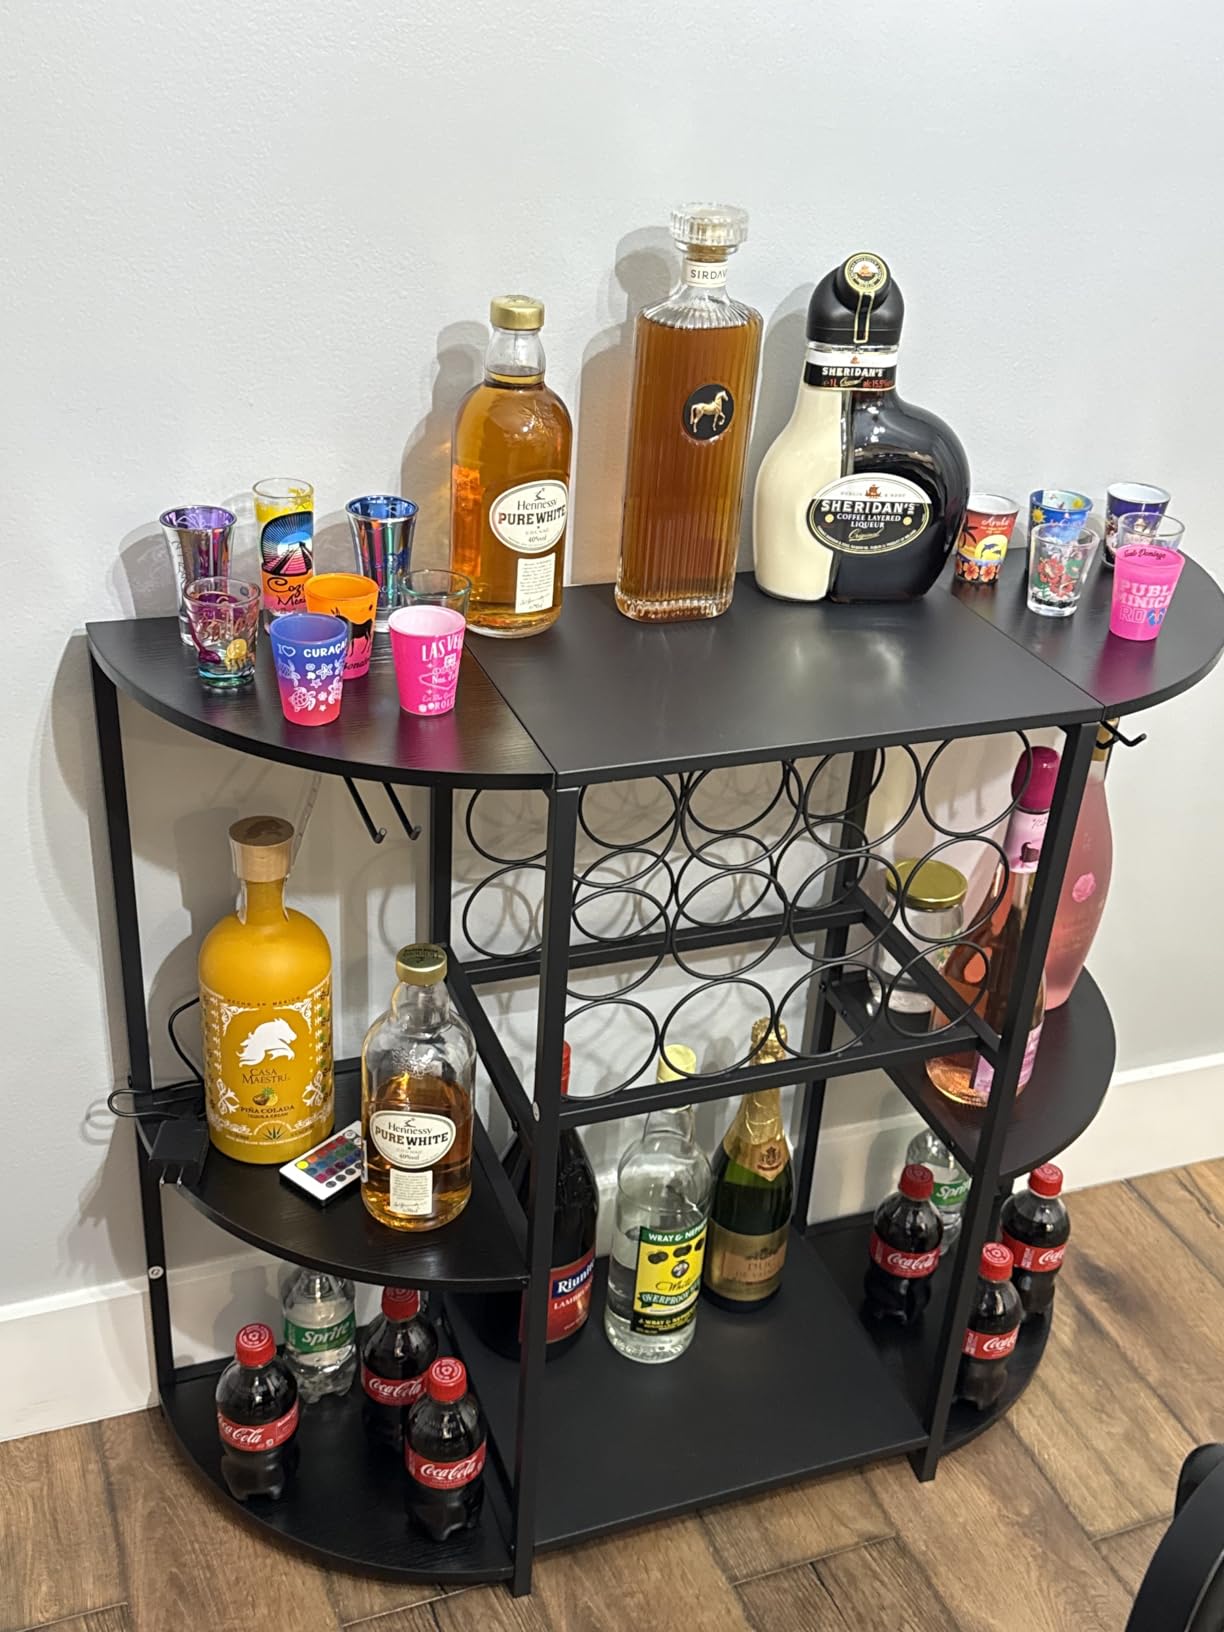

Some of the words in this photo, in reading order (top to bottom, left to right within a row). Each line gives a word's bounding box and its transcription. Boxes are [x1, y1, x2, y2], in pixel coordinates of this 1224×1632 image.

[822, 367, 884, 377] SHERIDAN'S
[517, 497, 558, 511] Hennessy
[821, 500, 915, 515] SHERIDAN'S
[498, 512, 535, 525] PURE
[536, 504, 566, 524] WHITE
[837, 513, 866, 521] COFFEE
[867, 514, 901, 522] LAYERED
[850, 521, 885, 529] LIQUEUR
[421, 639, 446, 662] LAS
[249, 1068, 278, 1078] CASA
[240, 1105, 258, 1114] PIÑA
[260, 1105, 295, 1115] COLADA
[388, 1121, 432, 1136] Hennessy
[375, 1126, 405, 1146] PURE
[405, 1131, 449, 1147] WHITE
[648, 1232, 674, 1243] WRAY
[674, 1233, 684, 1242] &
[301, 1321, 351, 1346] Sprite
